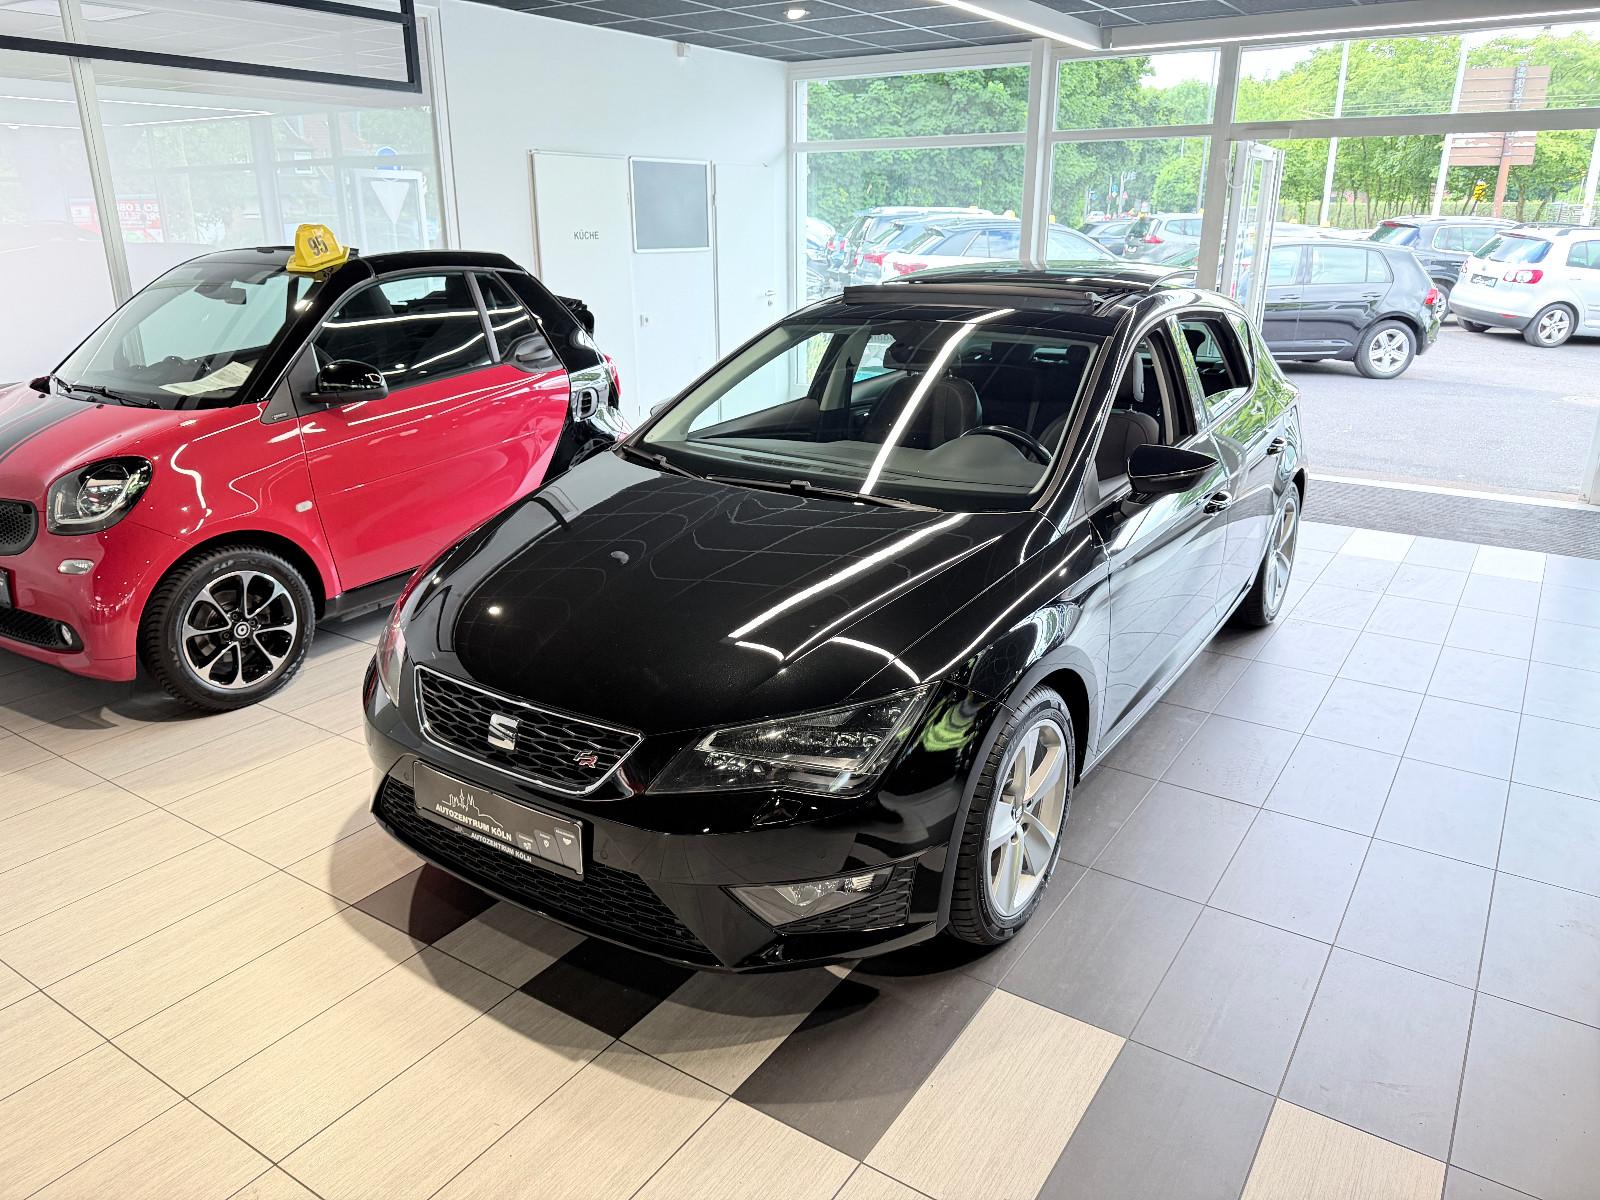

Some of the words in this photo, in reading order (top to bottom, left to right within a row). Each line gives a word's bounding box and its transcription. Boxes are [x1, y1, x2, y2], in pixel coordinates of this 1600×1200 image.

[307, 235, 329, 256] 95
[573, 229, 600, 240] KÜCHE
[435, 803, 490, 833] AUTOZENTRUM
[490, 826, 512, 842] KÖLN
[470, 832, 515, 856] AUTOZENTRUM
